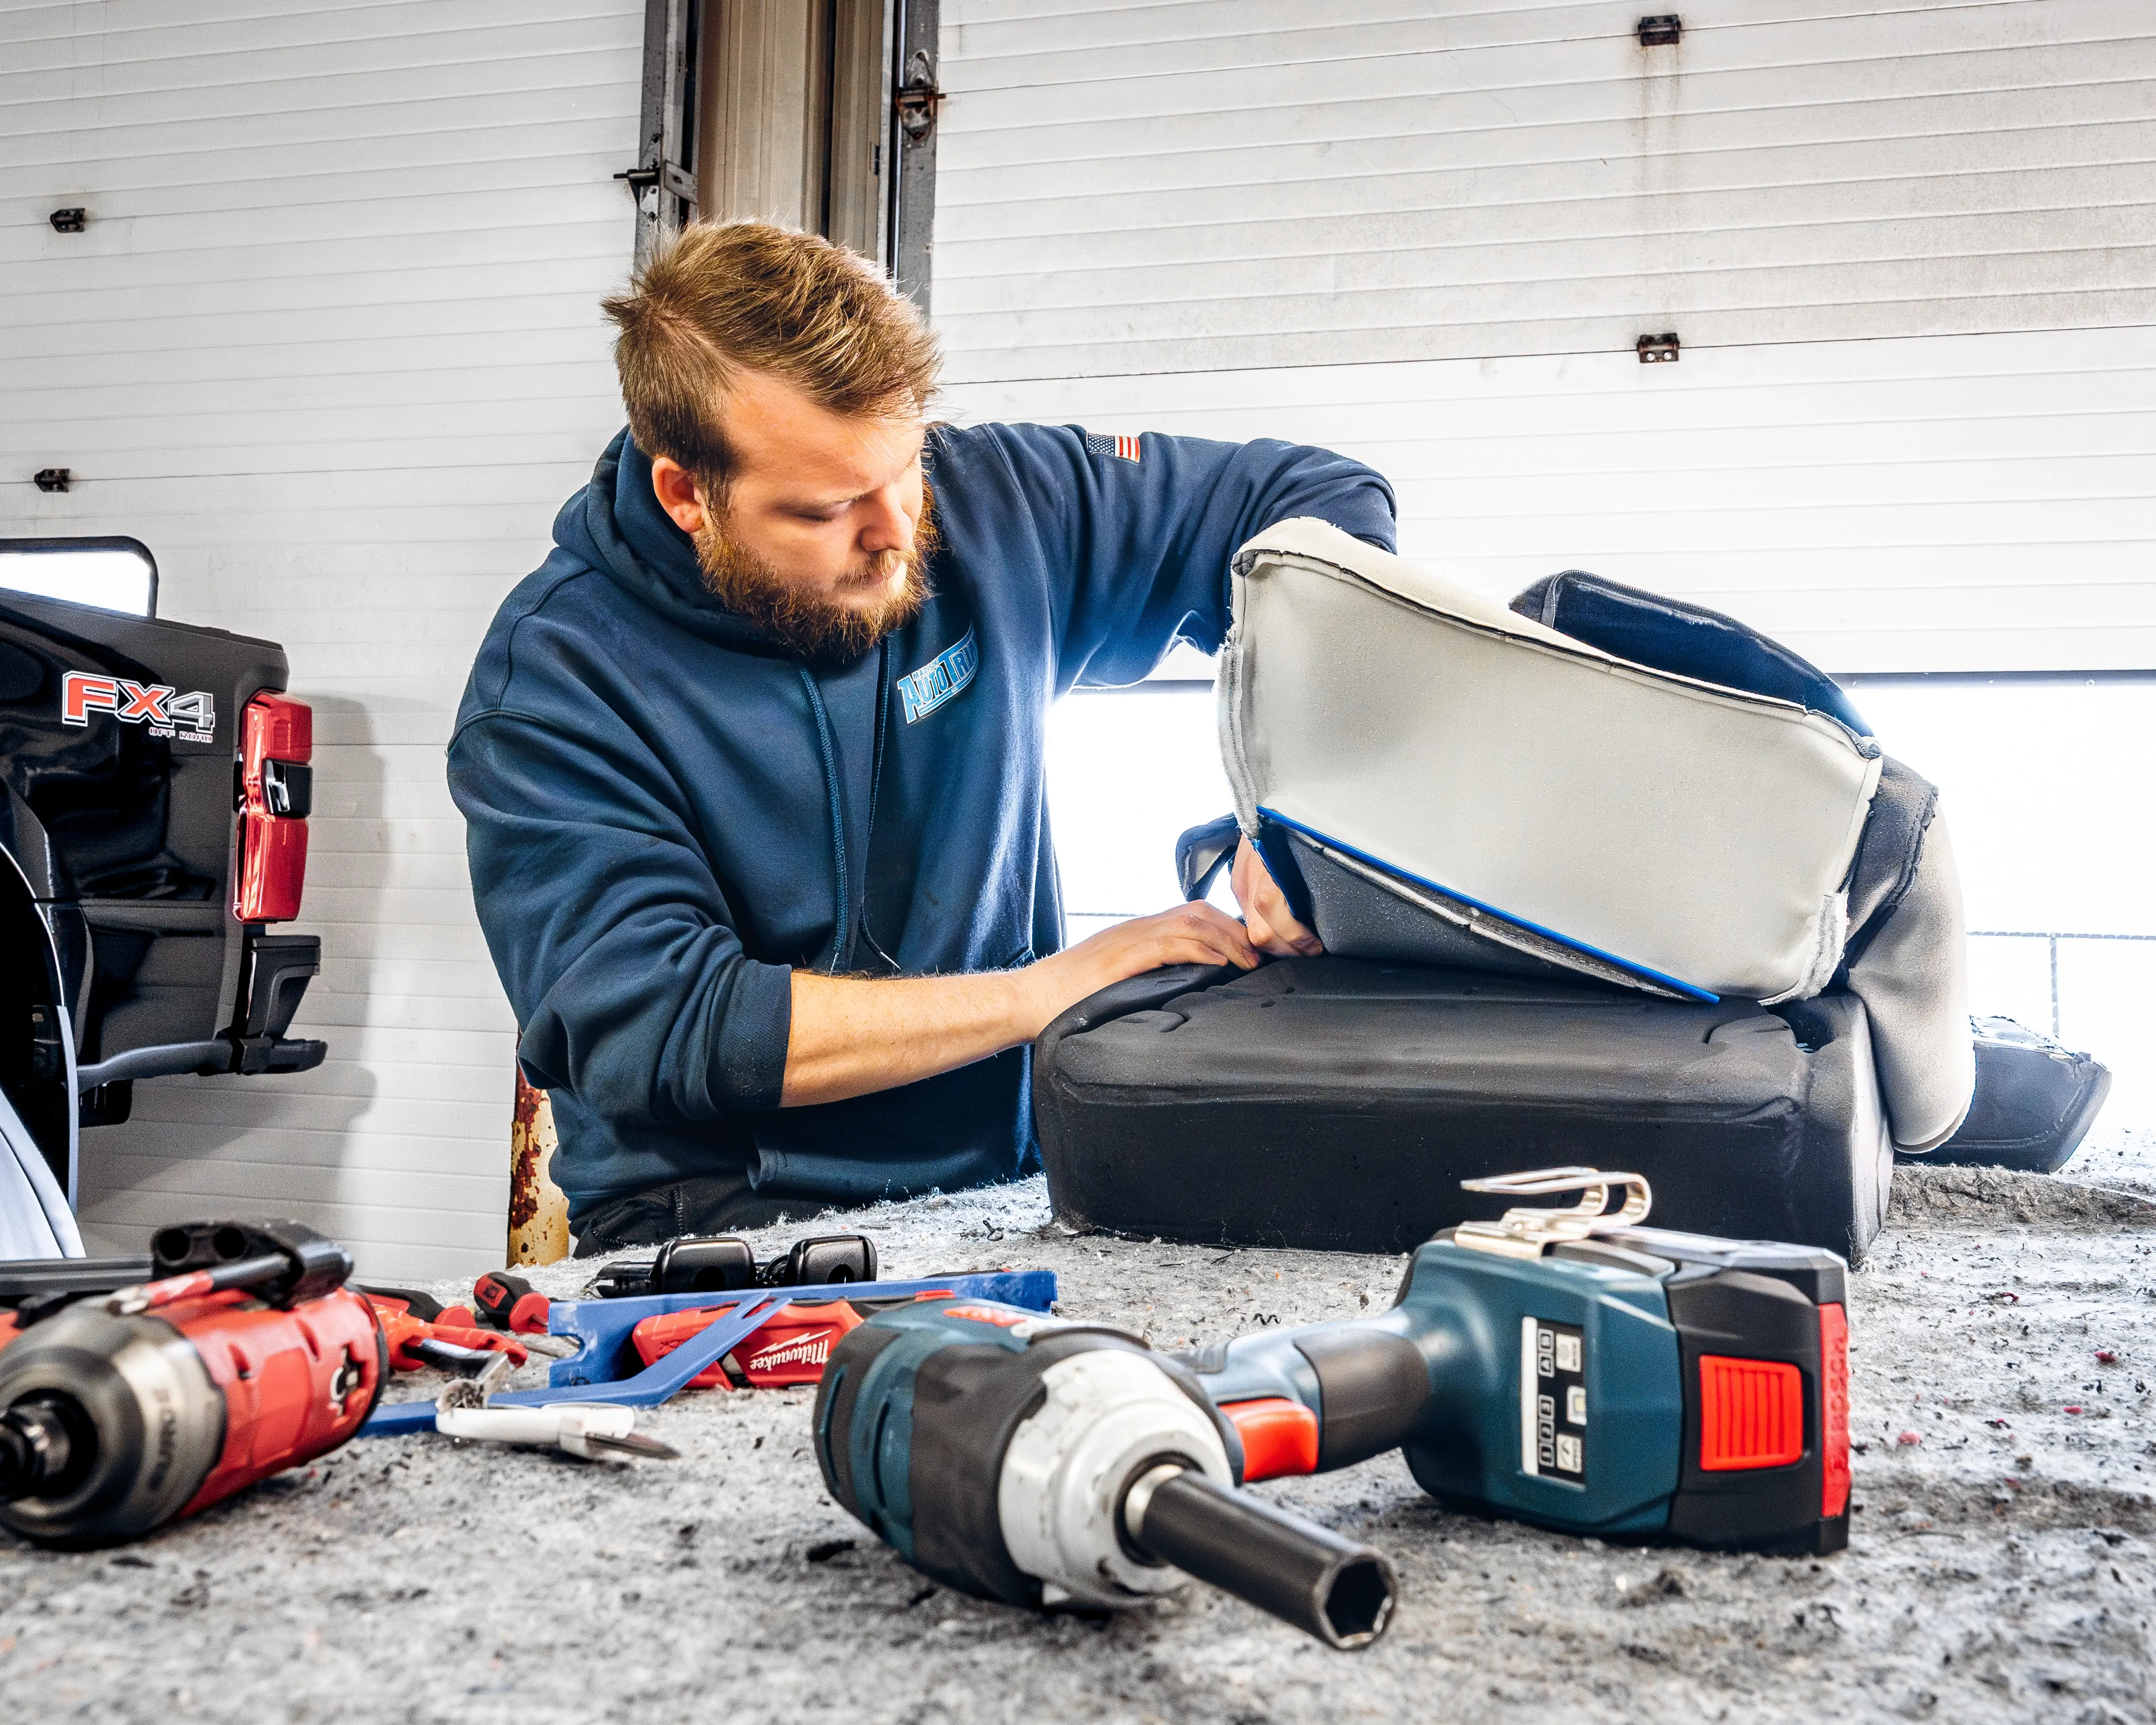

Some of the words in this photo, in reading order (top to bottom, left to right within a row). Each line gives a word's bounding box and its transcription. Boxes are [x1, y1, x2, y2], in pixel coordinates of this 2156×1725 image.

[912, 658, 939, 681] MADISON
[62, 671, 215, 734] FX4
[149, 727, 176, 738] OFF
[750, 1339, 829, 1372] Milwaukee
